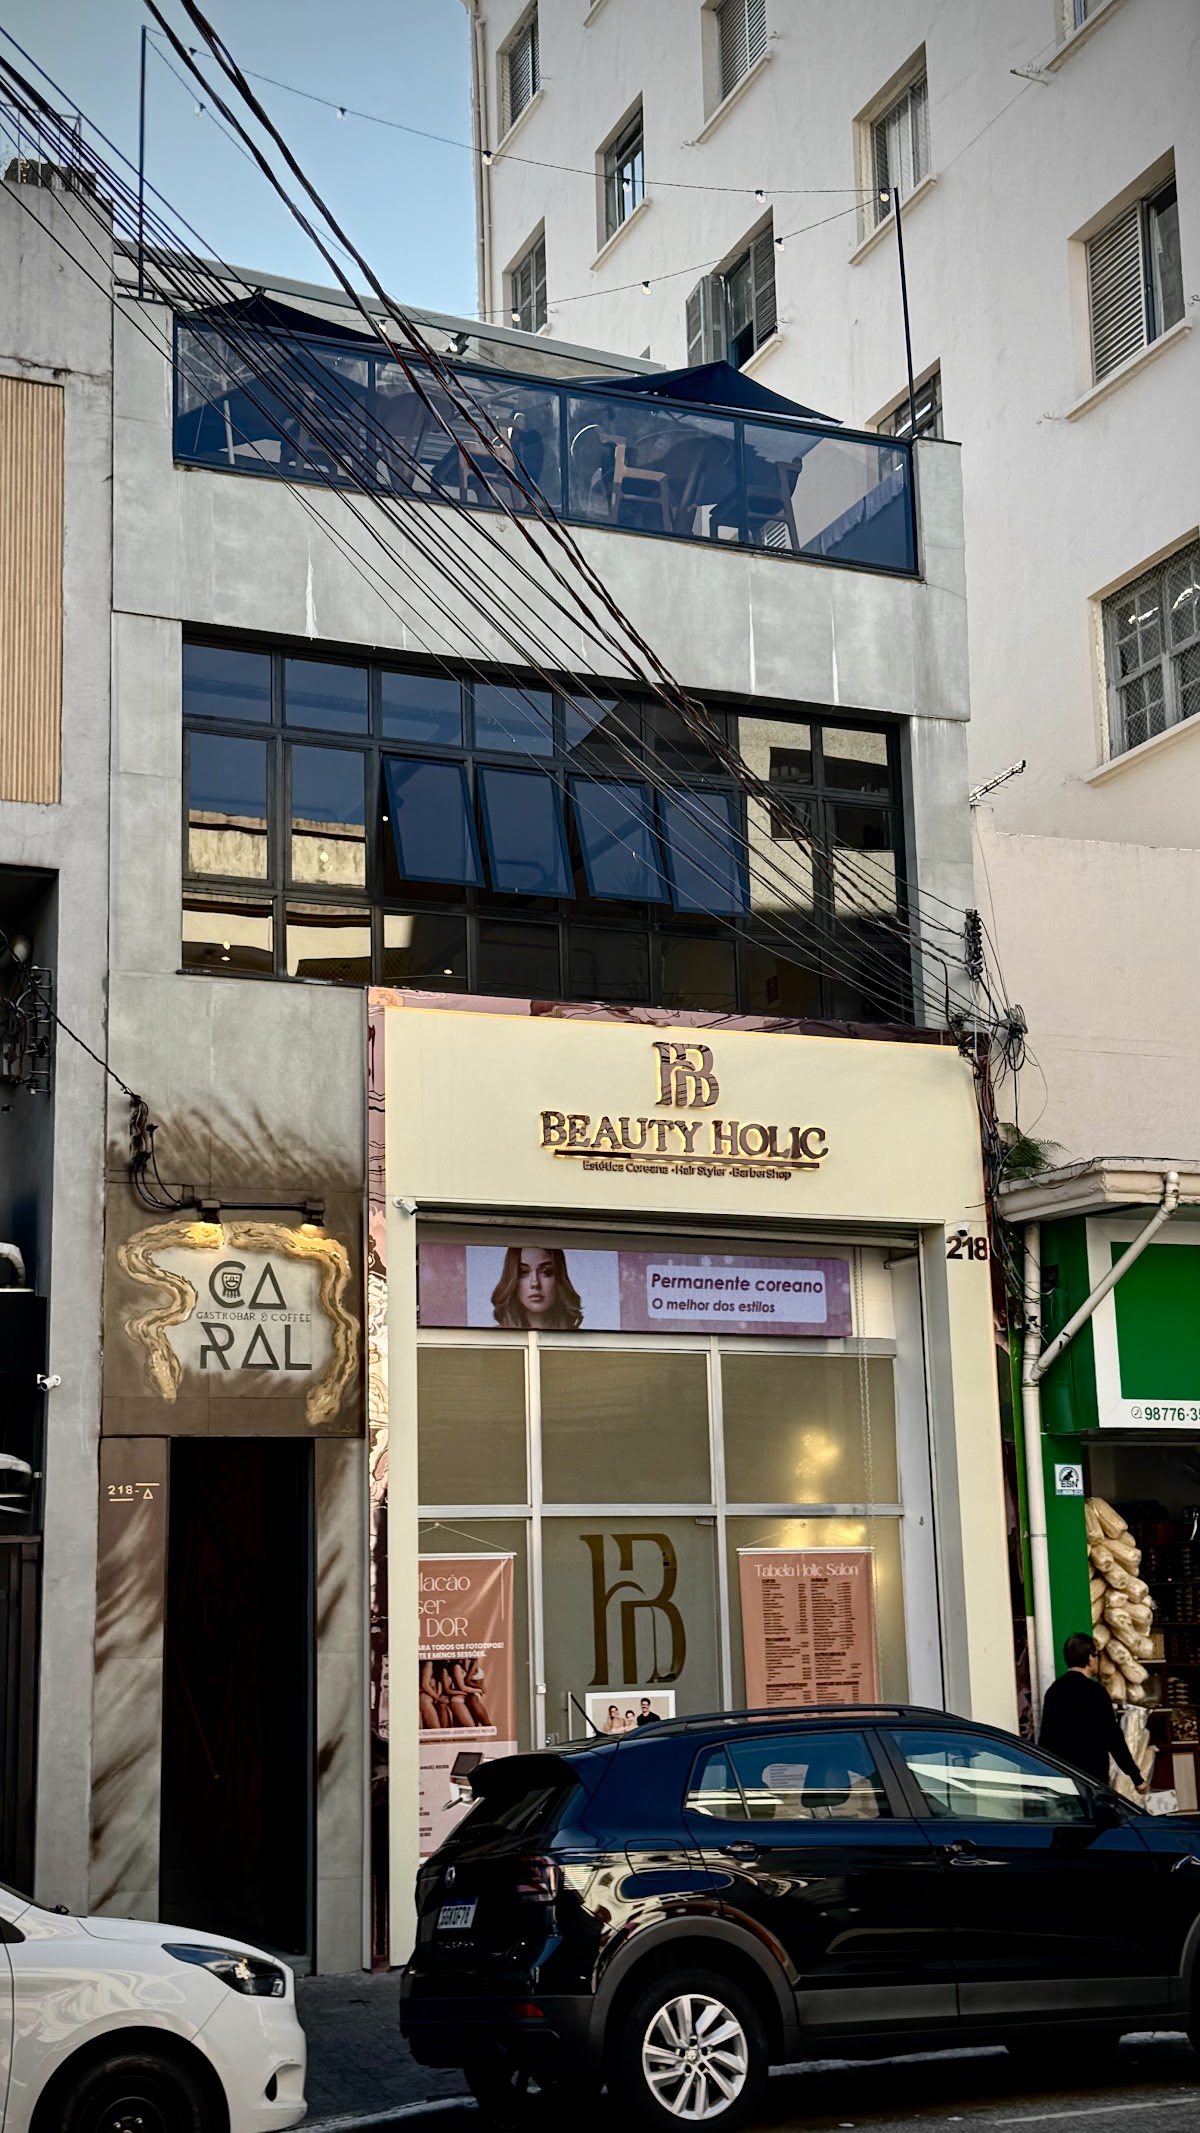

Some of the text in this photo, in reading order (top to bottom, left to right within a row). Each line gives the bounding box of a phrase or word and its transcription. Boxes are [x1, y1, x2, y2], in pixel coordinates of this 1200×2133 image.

[540, 1110, 829, 1160] BEAUTY HOLIC
[582, 1160, 624, 1172] Estética
[626, 1162, 669, 1175] Coreana
[946, 1235, 988, 1261] 218
[651, 1273, 823, 1294] Permanente coreano
[652, 1298, 776, 1313] O melhor dos estilos
[196, 1311, 256, 1321] GASTROBAR
[270, 1313, 312, 1322] COFFEE
[754, 1563, 859, 1577] Tabela Holic Salon
[418, 1599, 446, 1615] ser
[426, 1616, 469, 1638] DOR
[431, 1643, 455, 1651] TODOS
[432, 1651, 456, 1659] MENOS
